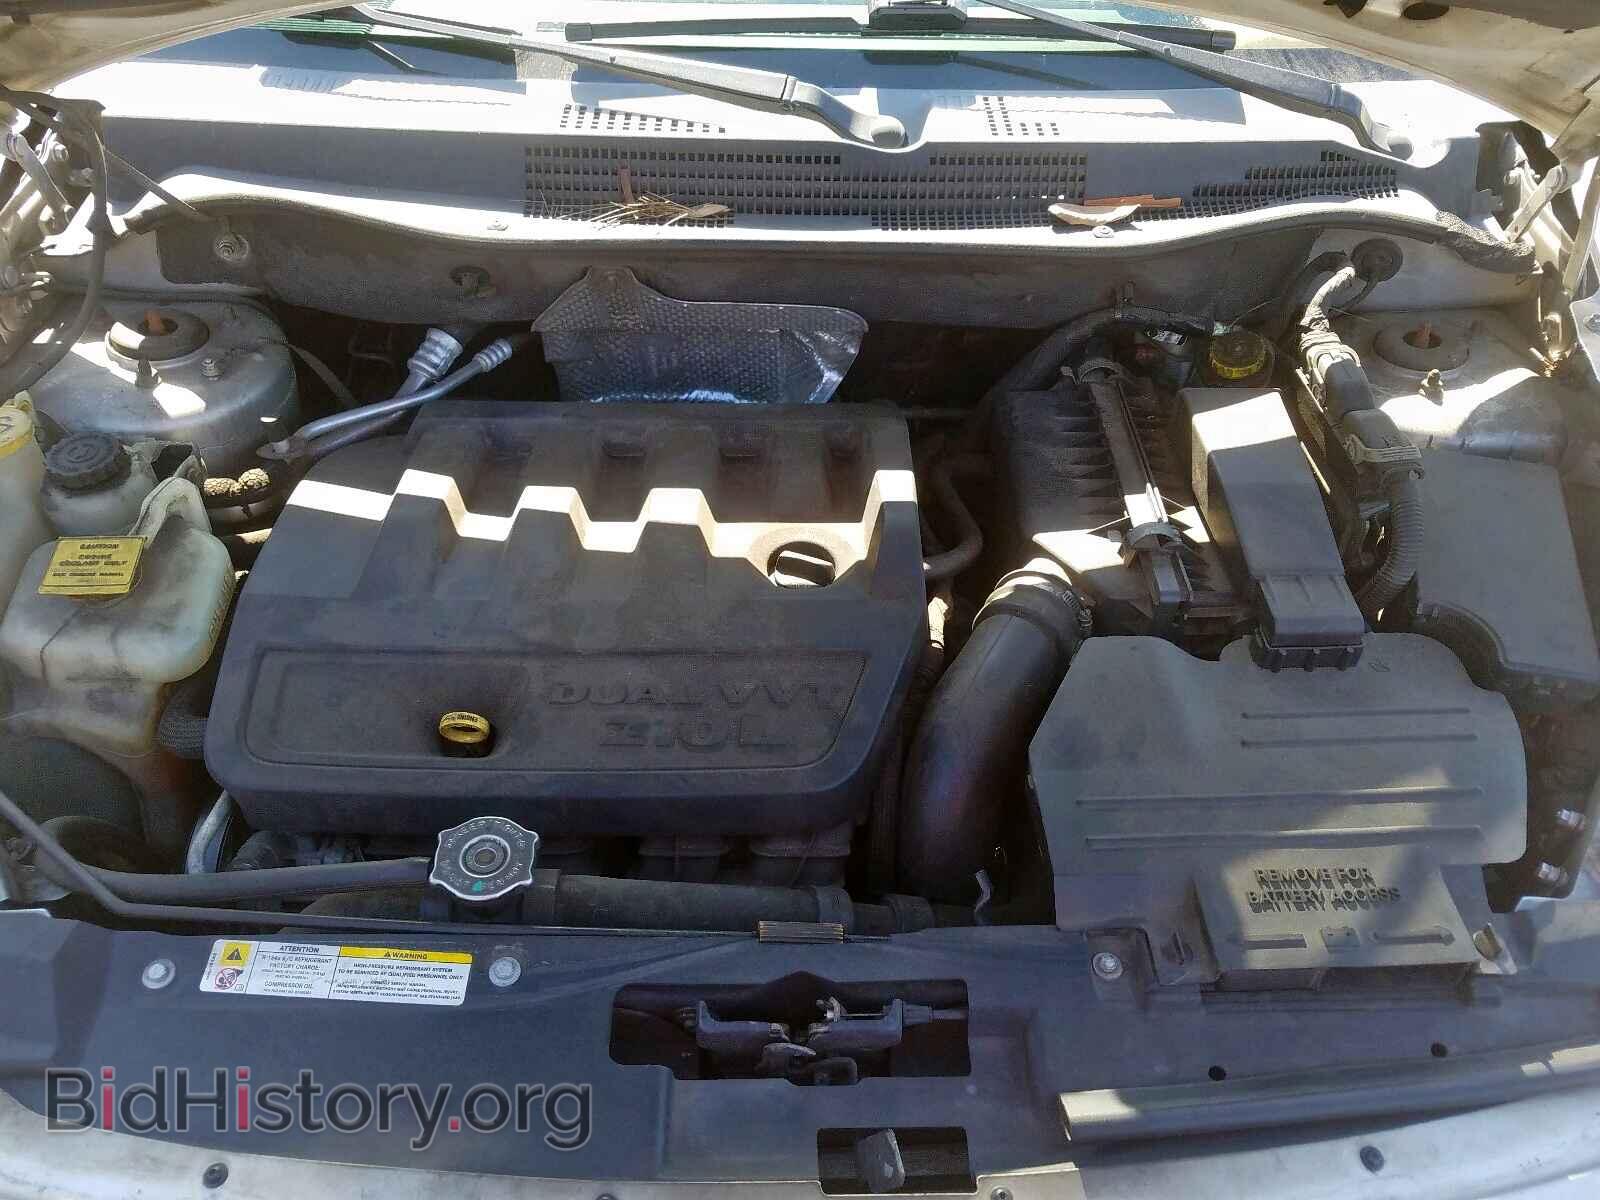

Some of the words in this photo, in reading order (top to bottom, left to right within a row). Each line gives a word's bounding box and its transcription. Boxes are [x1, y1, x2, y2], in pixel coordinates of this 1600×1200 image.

[548, 682, 704, 706] DUAL
[1254, 867, 1336, 890] REMOVE
[1337, 867, 1377, 888] FOR
[1248, 889, 1327, 914] BATTERY
[1331, 887, 1401, 912] ACCESS
[279, 945, 320, 953] ATTENTION
[392, 952, 428, 960] WARNING
